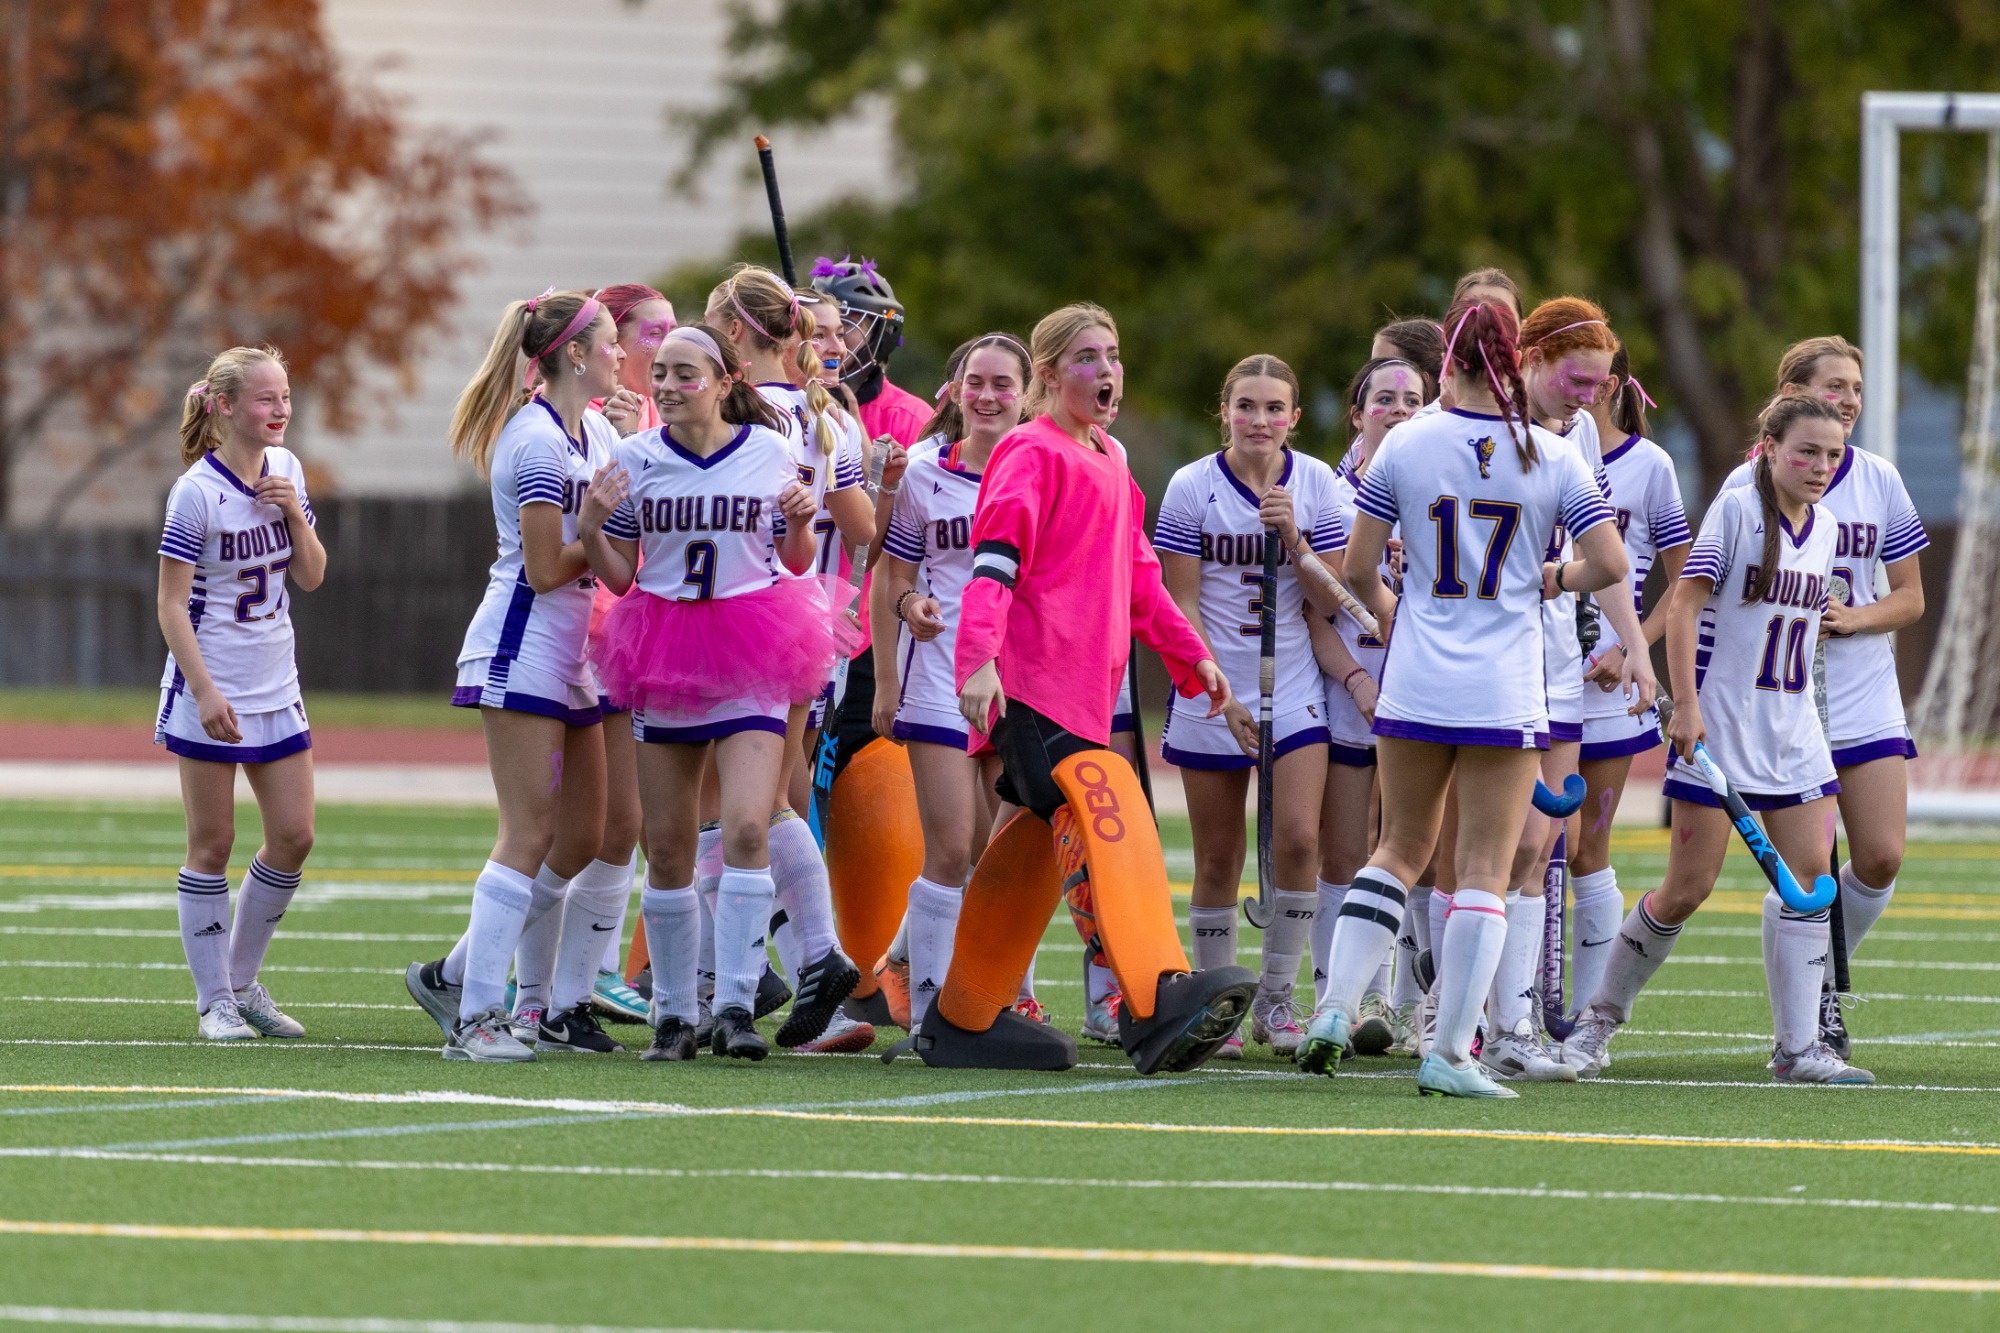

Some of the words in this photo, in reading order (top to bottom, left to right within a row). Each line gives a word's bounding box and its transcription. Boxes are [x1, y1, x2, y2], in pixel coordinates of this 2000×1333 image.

[642, 495, 762, 533] BOULDER
[677, 539, 718, 602] 9
[1429, 494, 1521, 600] 17
[235, 556, 291, 623] 27
[1755, 614, 1808, 694] 10
[816, 731, 839, 794] STX
[1074, 761, 1125, 843] OBO
[1735, 815, 1777, 861] STX
[1196, 927, 1230, 937] STX
[1285, 909, 1315, 920] STX
[1545, 867, 1562, 1003] GRYPHON
